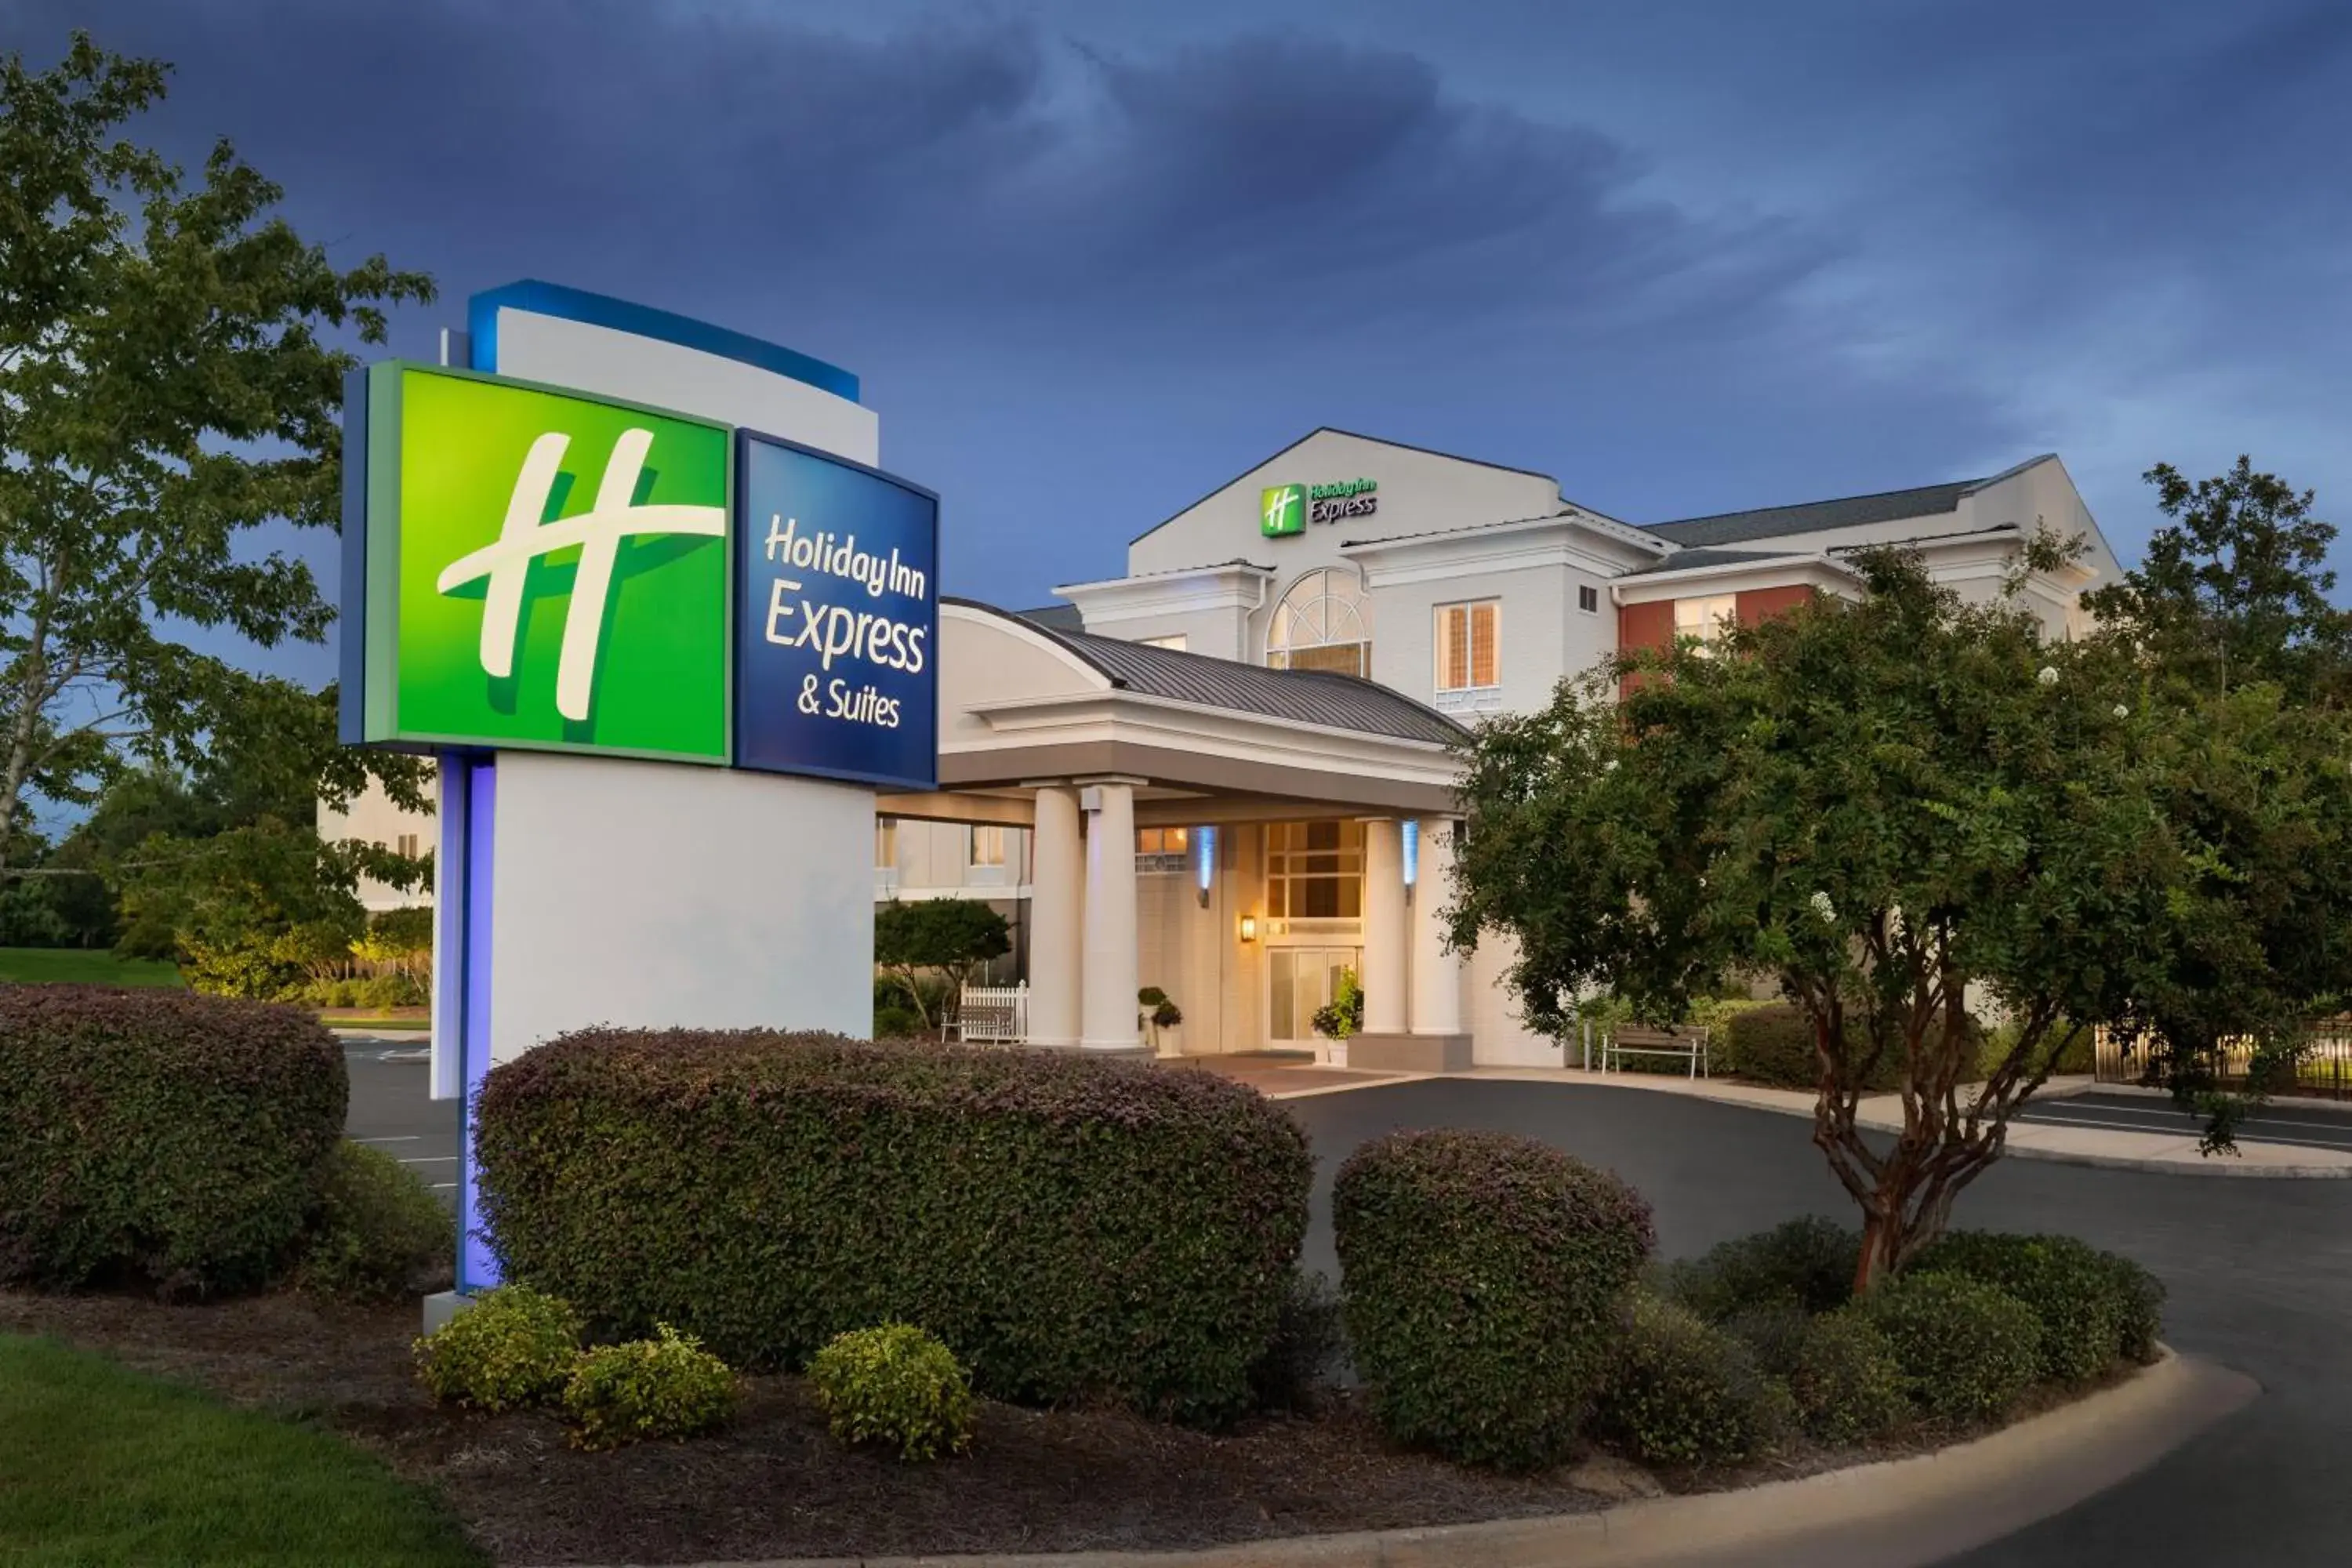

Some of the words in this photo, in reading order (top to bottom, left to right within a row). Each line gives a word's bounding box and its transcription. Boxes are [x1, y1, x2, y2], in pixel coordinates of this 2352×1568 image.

[1311, 480, 1354, 500] Holiday
[1311, 498, 1377, 524] Express
[765, 514, 887, 597] Holiday
[888, 548, 925, 601] Inn
[765, 579, 925, 673] Express
[797, 673, 820, 714] &
[826, 678, 901, 728] Suites
